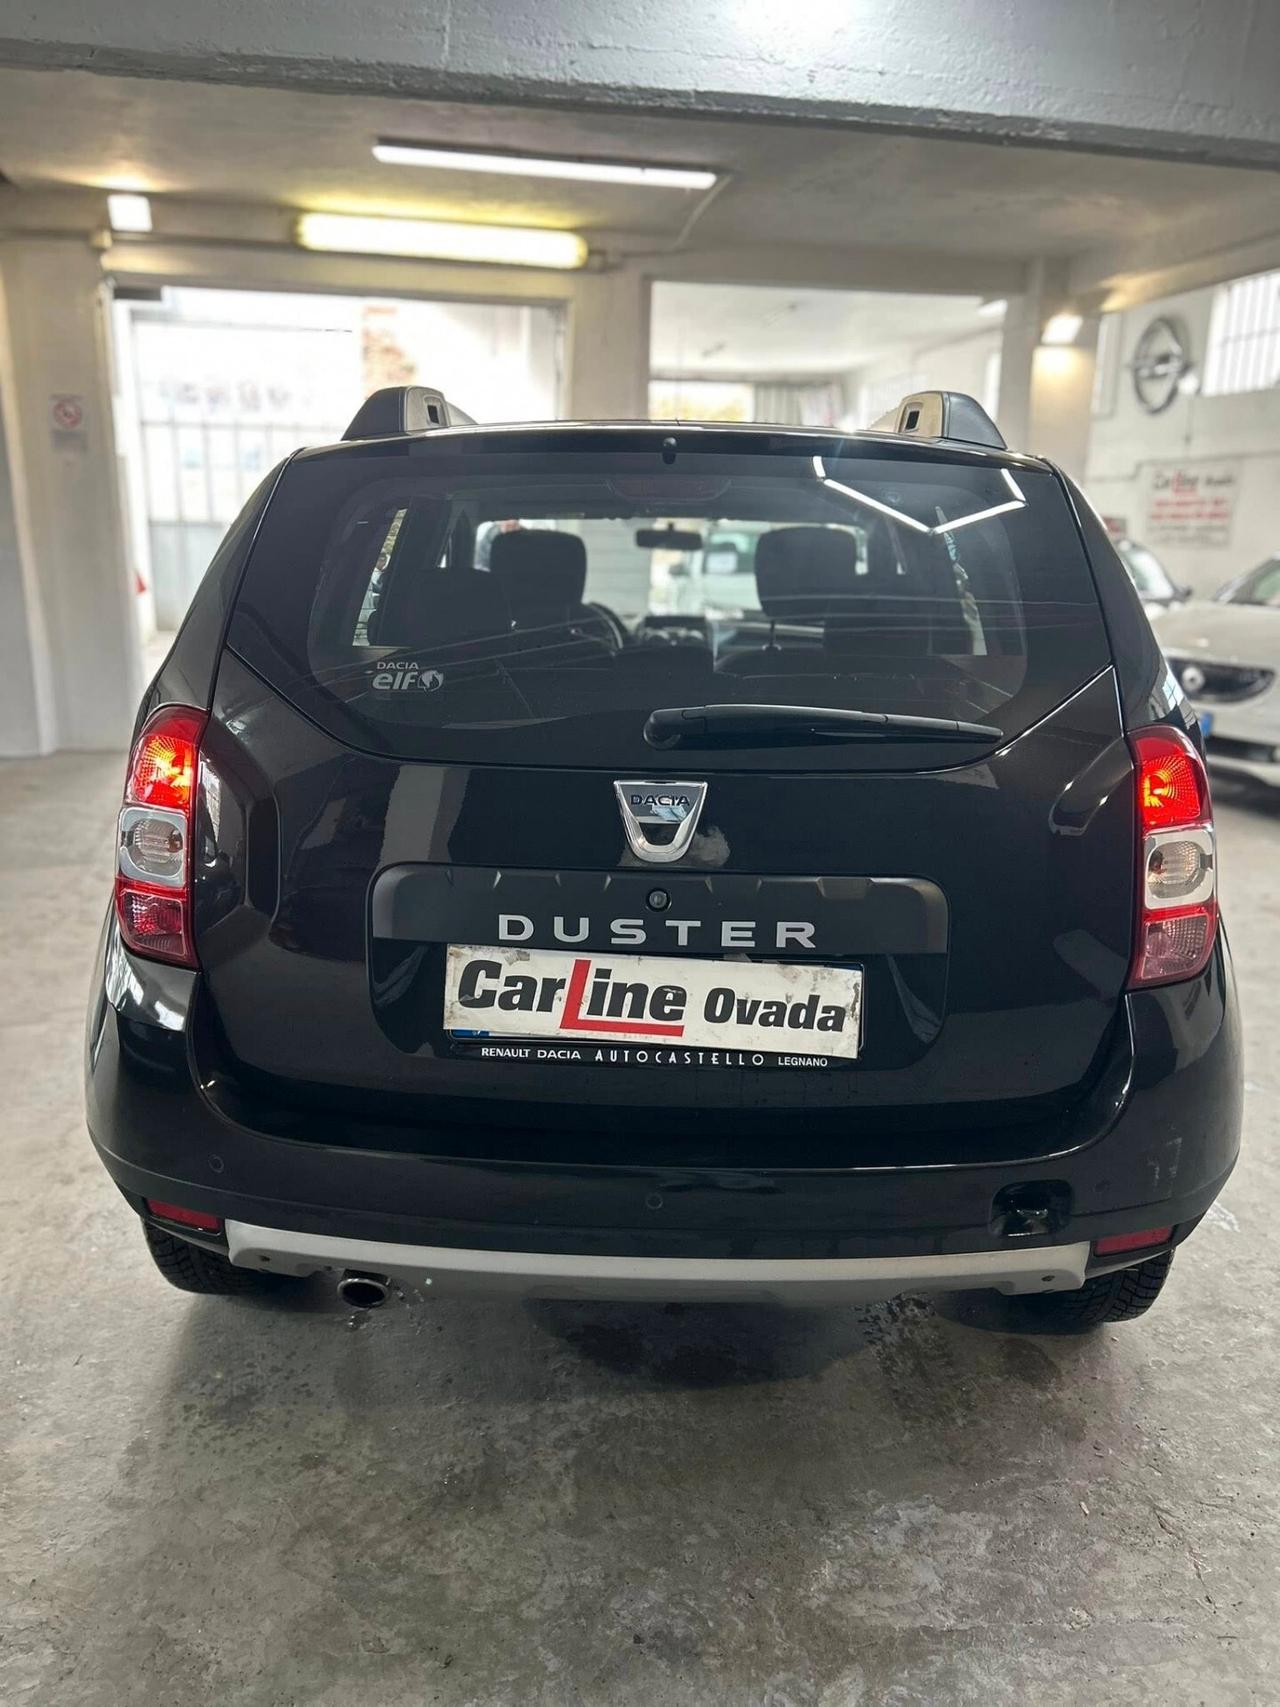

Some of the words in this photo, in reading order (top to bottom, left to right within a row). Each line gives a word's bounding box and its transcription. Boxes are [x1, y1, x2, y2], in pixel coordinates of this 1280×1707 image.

[376, 661, 420, 671] DACIA
[372, 671, 419, 690] elf
[630, 794, 691, 807] DACIA
[497, 914, 817, 949] DUSTER
[457, 958, 687, 1038] CarLine
[702, 986, 847, 1033] Ovada
[480, 1047, 531, 1059] RENAULT
[536, 1049, 582, 1060] DACIA
[594, 1049, 765, 1067] AUTOCASTELLO
[777, 1056, 829, 1068] LEGNANO
